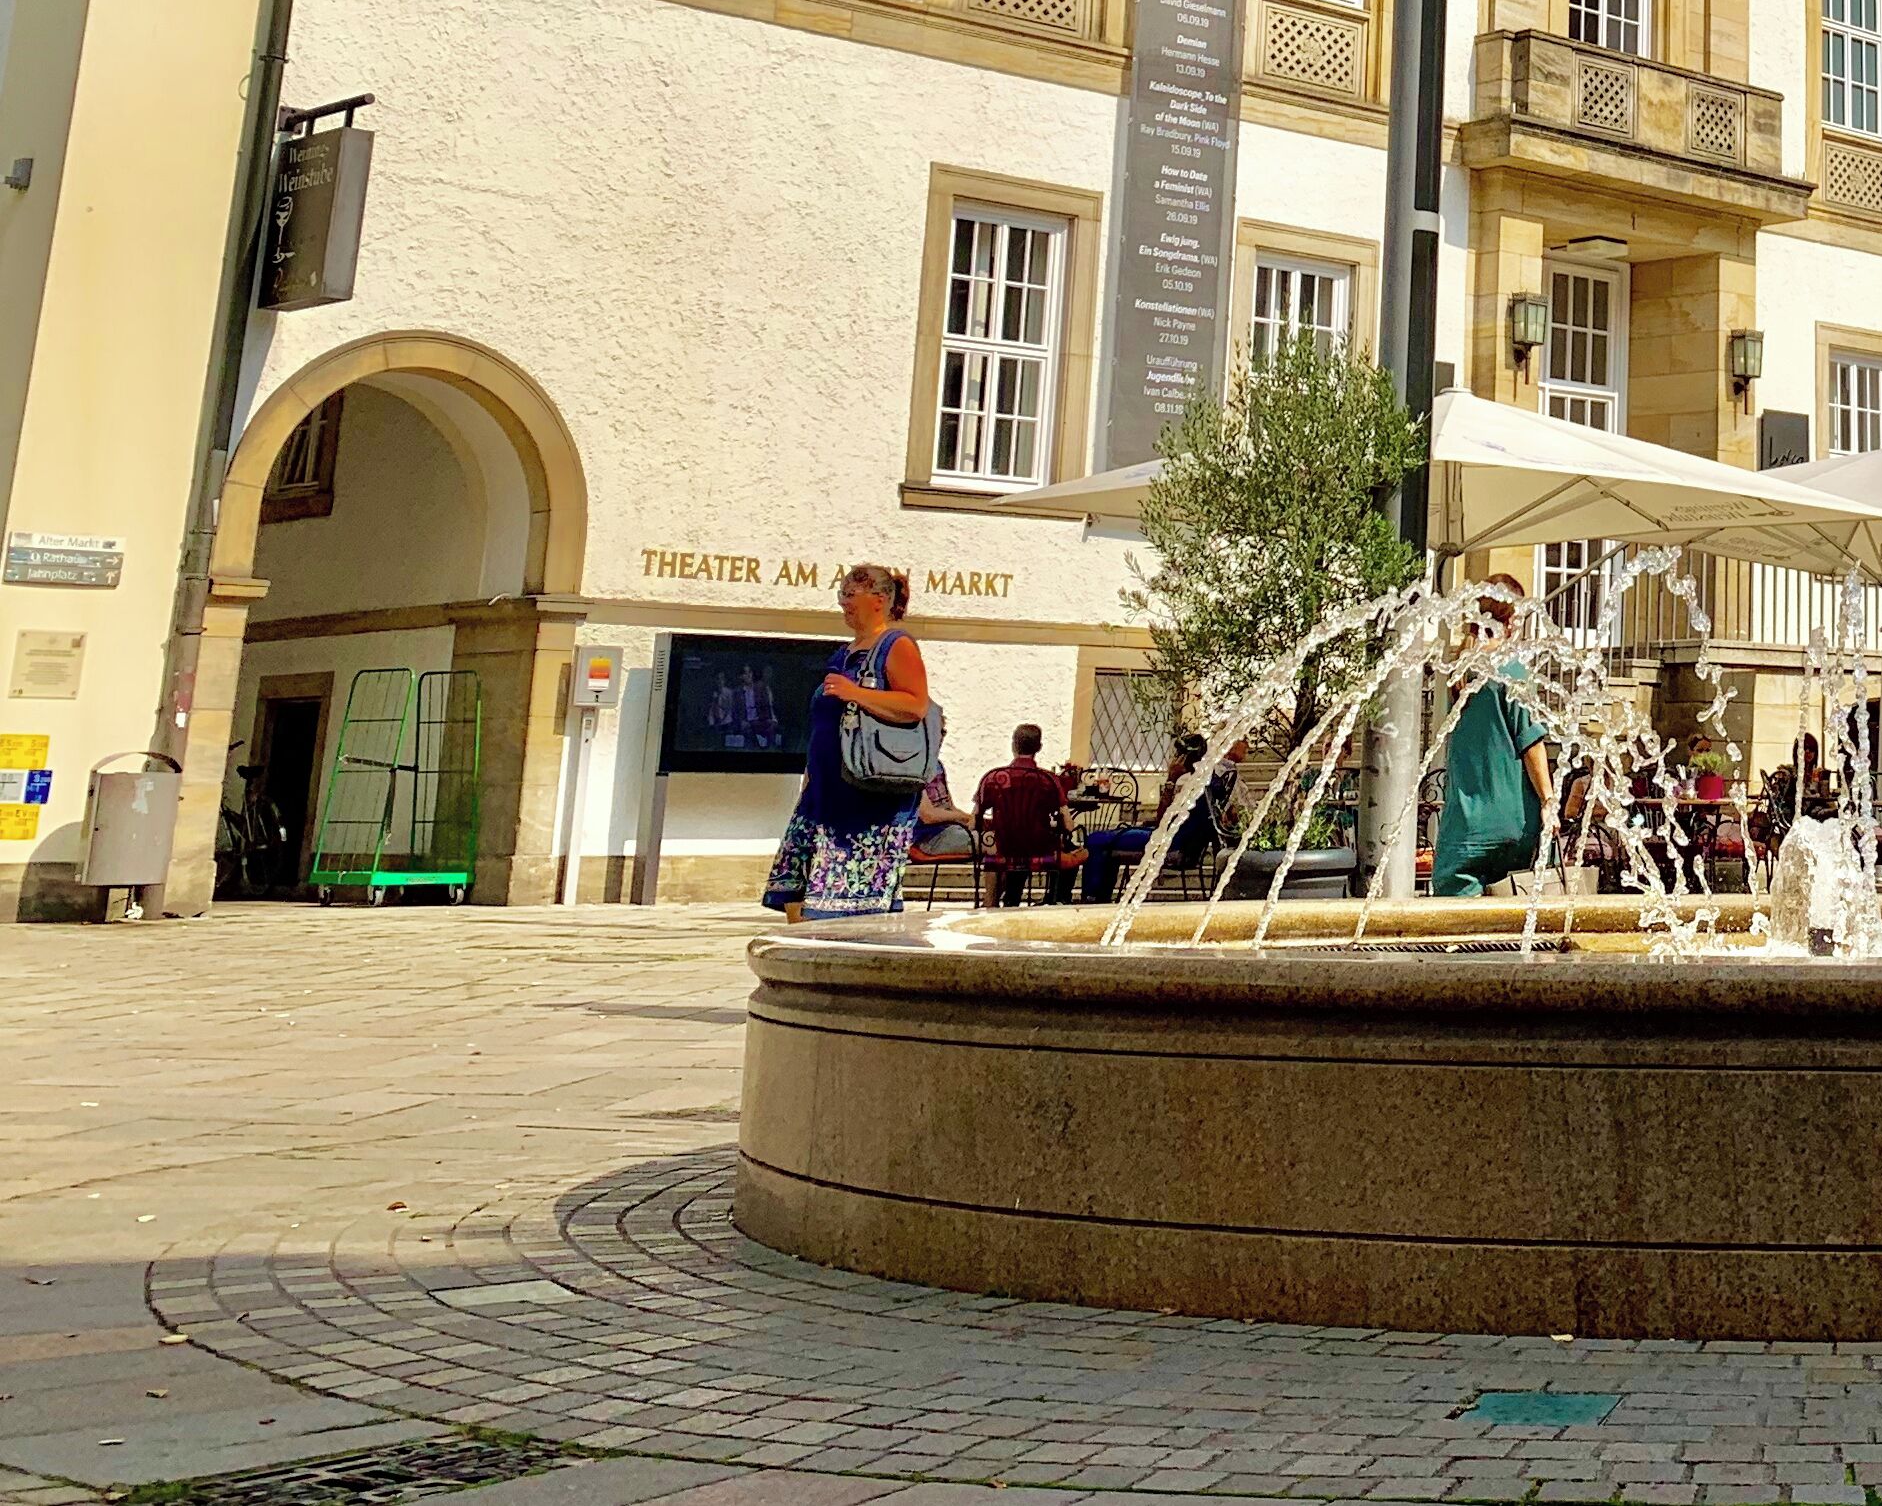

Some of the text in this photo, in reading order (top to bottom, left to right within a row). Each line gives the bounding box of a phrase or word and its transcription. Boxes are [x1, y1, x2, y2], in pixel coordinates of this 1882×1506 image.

[1161, 46, 1197, 62] Hermann
[1214, 94, 1228, 105] the
[1170, 100, 1208, 115] Dark Side
[1155, 112, 1164, 121] of
[1165, 113, 1178, 124] the
[1179, 116, 1201, 129] Moon
[1194, 132, 1210, 144] Pink
[1211, 134, 1231, 150] Floyd
[278, 163, 334, 194] Weinstube
[1161, 165, 1208, 182] How to Date
[1154, 181, 1160, 189] a
[1160, 179, 1194, 194] Feminist
[1155, 194, 1194, 209] Samantha
[1160, 232, 1180, 246] Ewig
[1139, 245, 1152, 256] Ein
[1155, 263, 1170, 274] Erik
[1135, 298, 1198, 316] Konstellationen
[1153, 317, 1196, 332] Nick Payne
[1146, 354, 1198, 373] Uraufführung
[39, 535, 100, 549] Alter Markt
[640, 548, 761, 584] THEATER
[774, 560, 818, 588] AM
[924, 570, 1013, 598] MARKT
